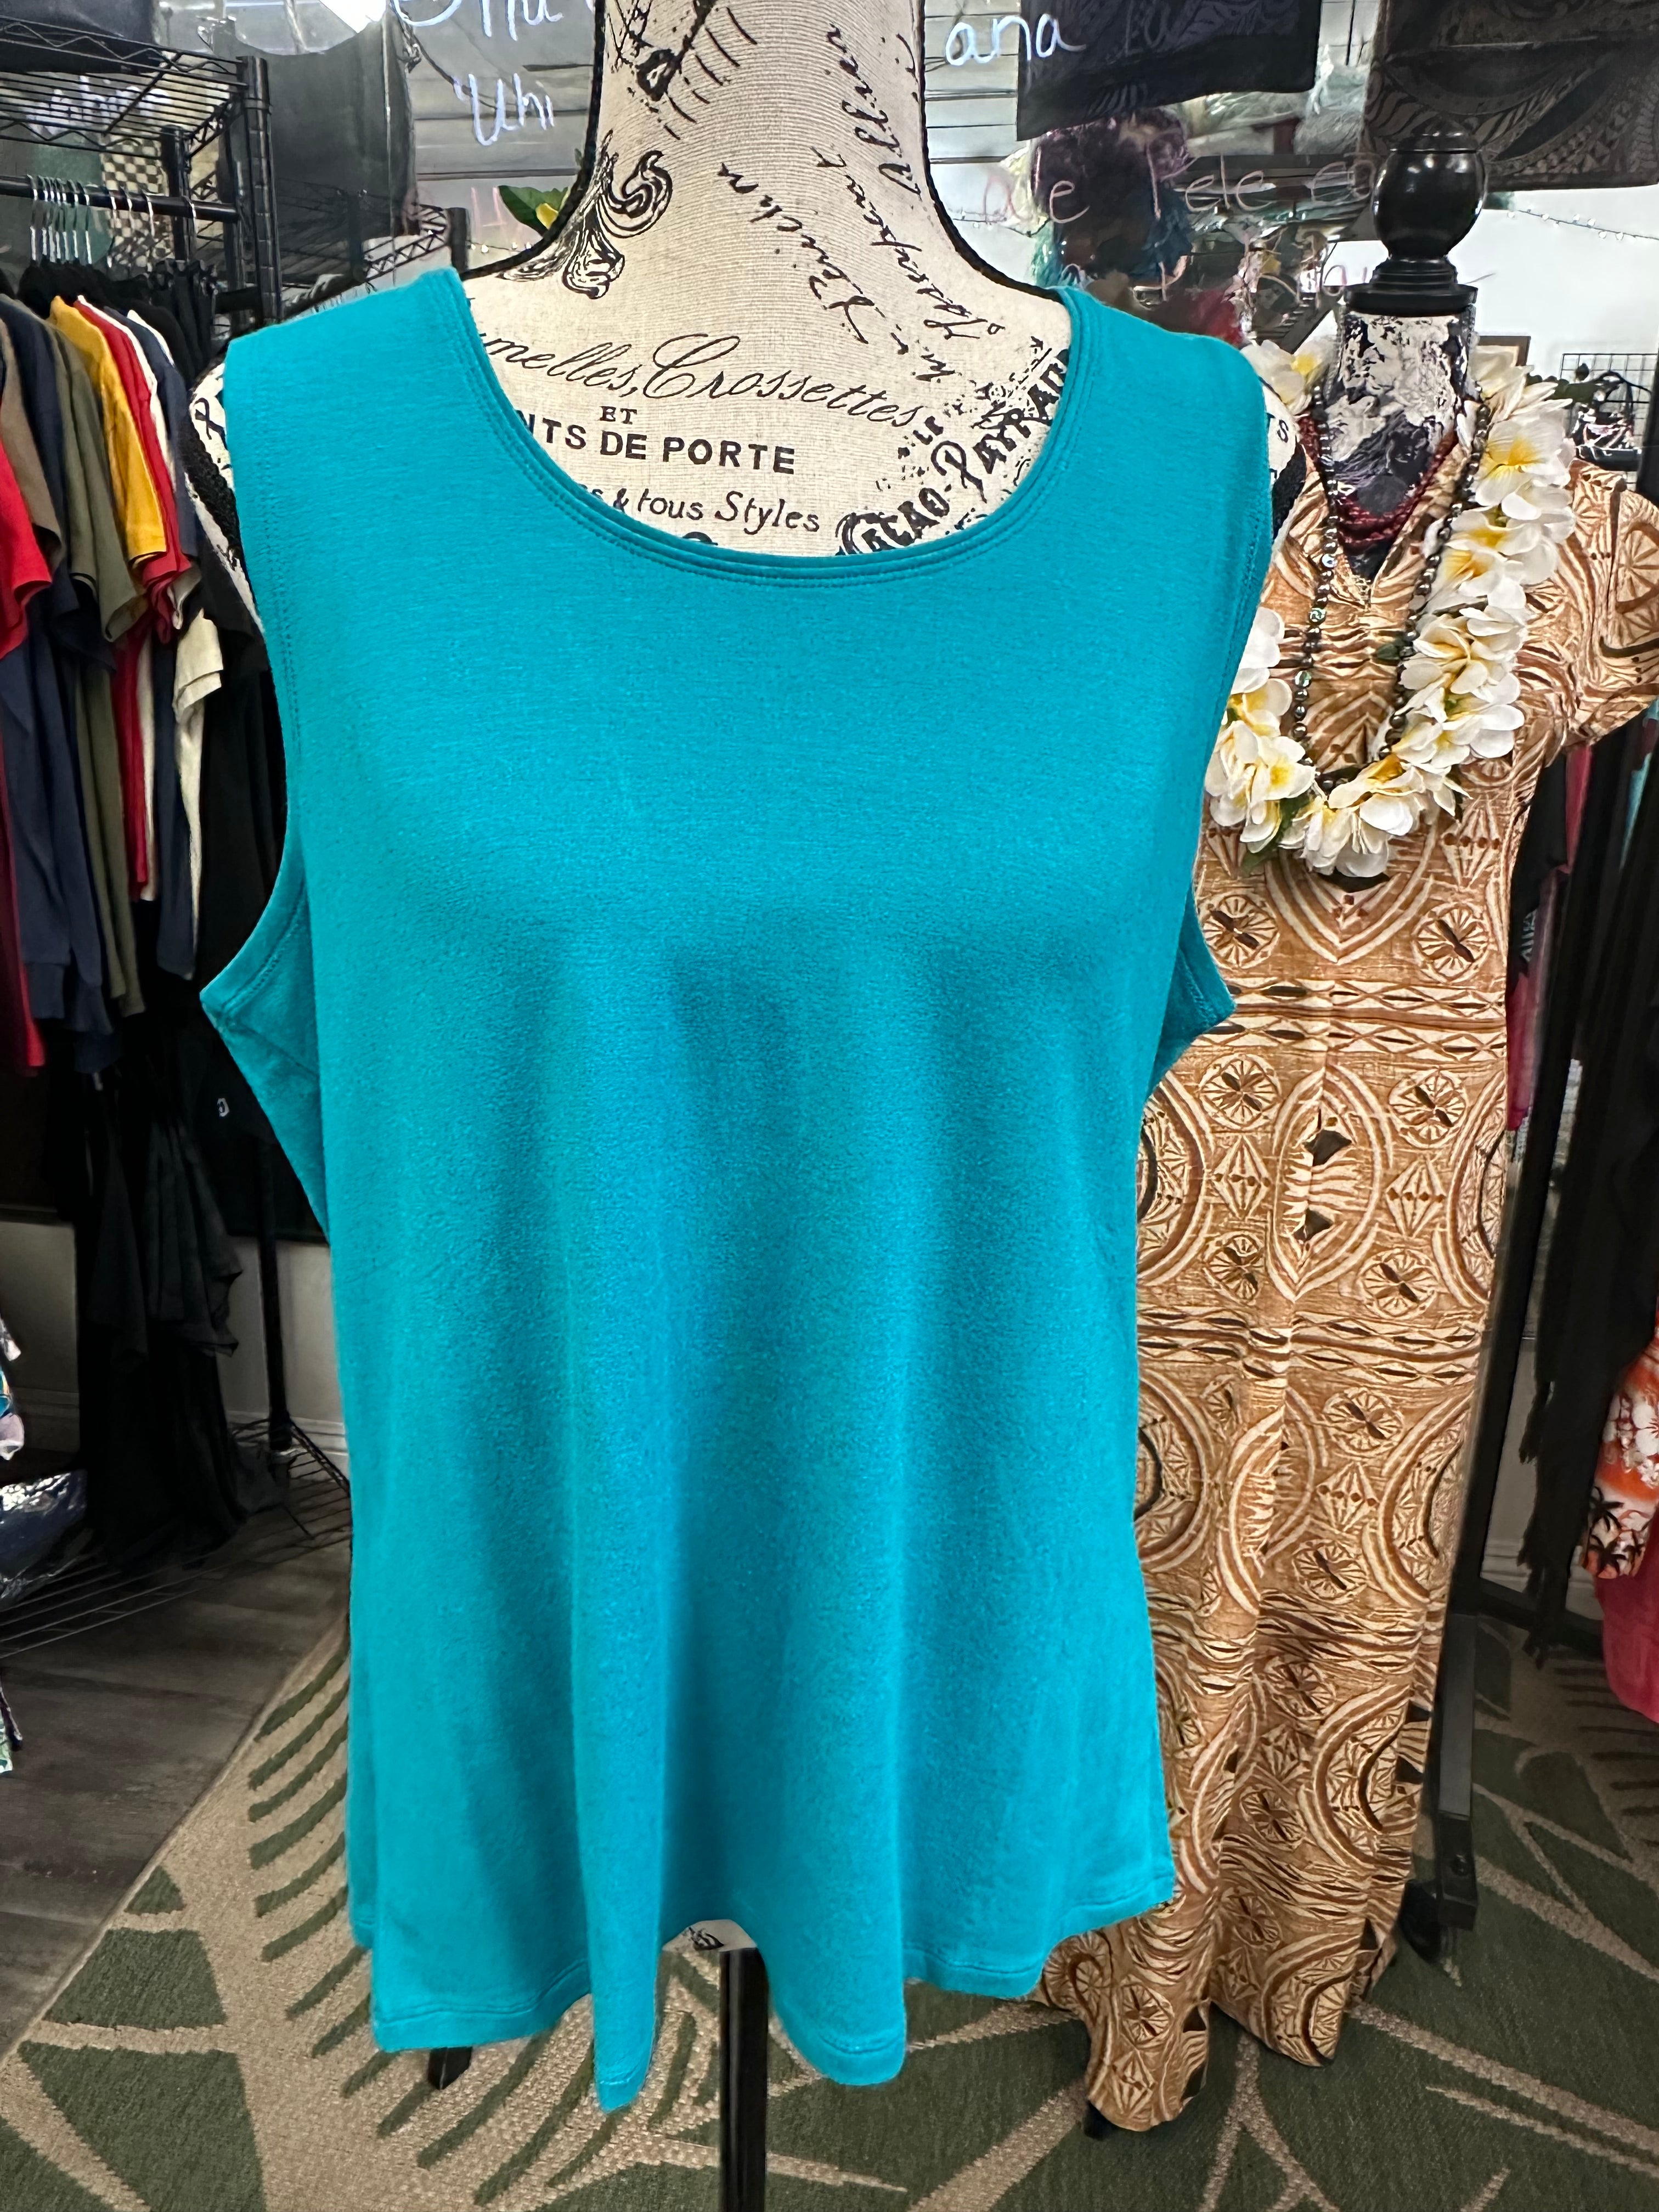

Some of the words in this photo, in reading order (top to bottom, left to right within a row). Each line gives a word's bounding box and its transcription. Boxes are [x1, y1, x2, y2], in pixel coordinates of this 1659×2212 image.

[478, 332, 641, 398] melles,
[642, 333, 924, 427] Crossettes
[599, 405, 637, 425] ET
[600, 430, 647, 460] DE
[662, 437, 795, 475] PORTE
[637, 488, 704, 521] tous
[714, 490, 821, 535] Styles
